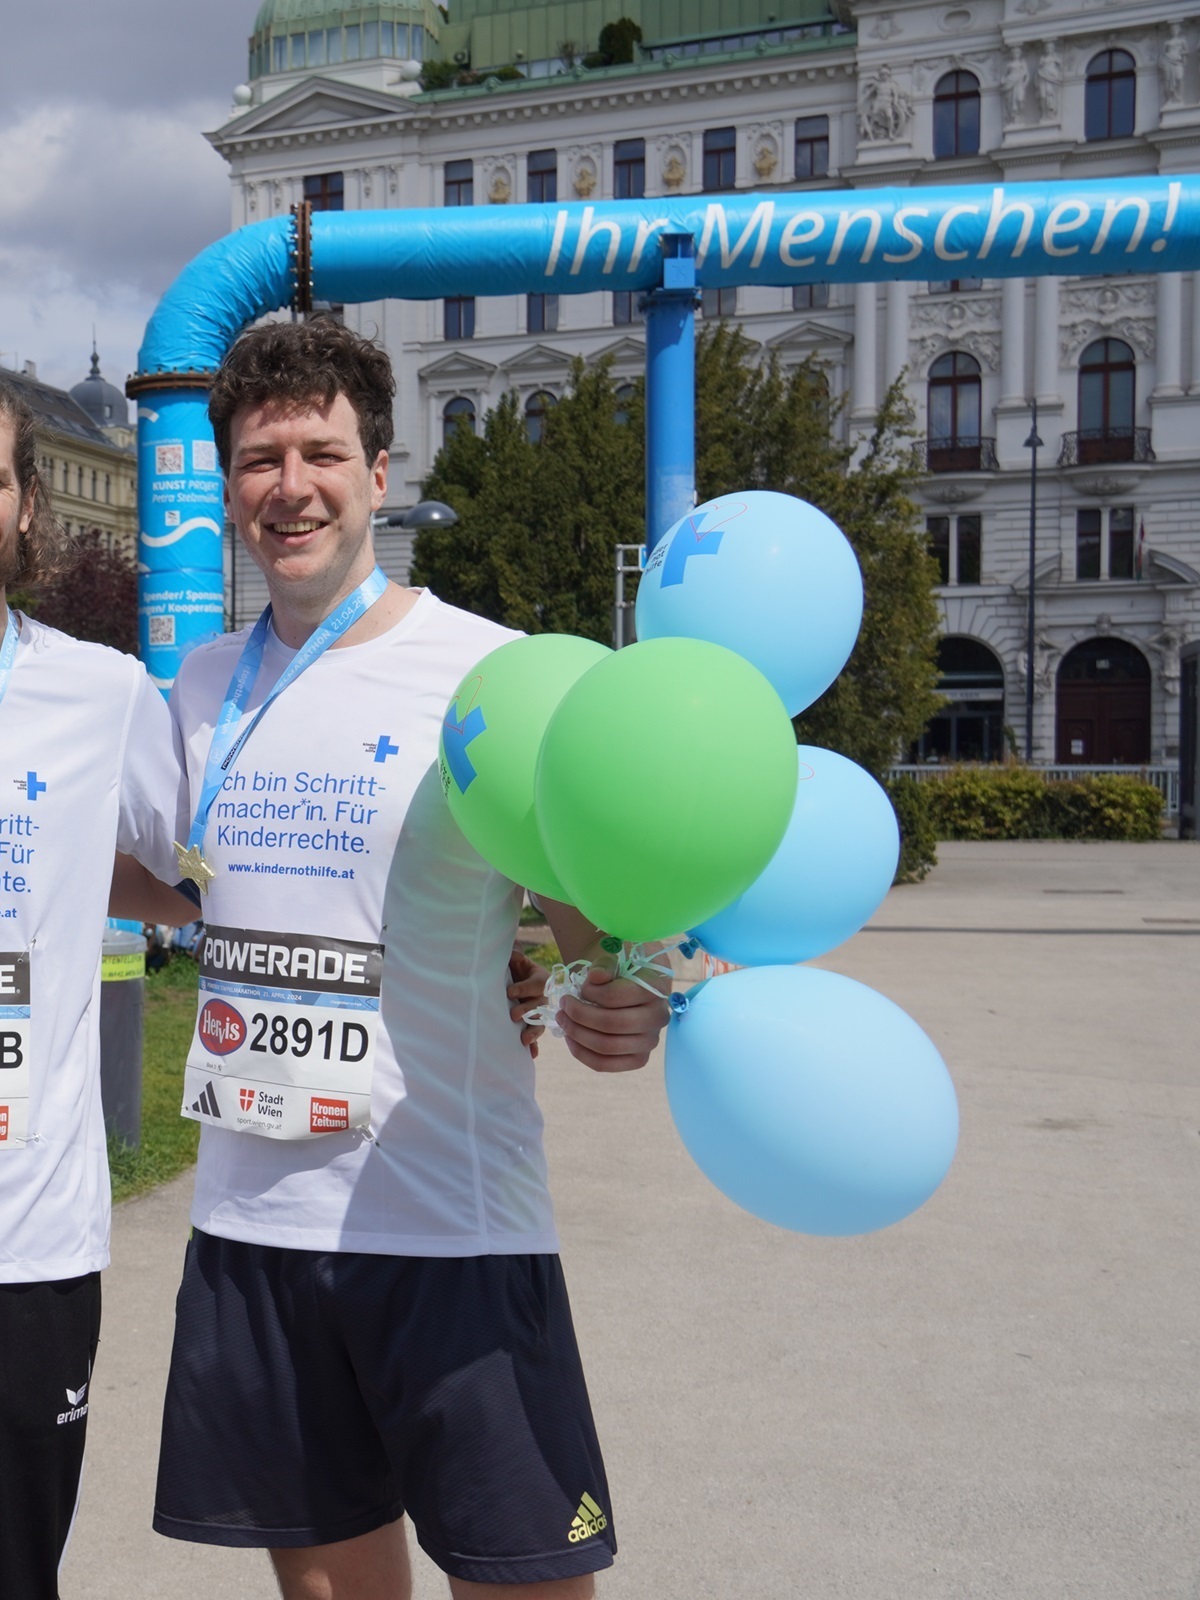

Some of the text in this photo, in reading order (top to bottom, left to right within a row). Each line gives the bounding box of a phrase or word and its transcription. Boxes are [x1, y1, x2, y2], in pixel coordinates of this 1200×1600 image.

[543, 181, 1182, 276] Ihr Menschen!
[152, 480, 186, 491] KUNST
[222, 771, 386, 796] ch bin Schritt-
[335, 801, 378, 824] Für
[217, 825, 370, 854] Kinderrechte.
[228, 863, 355, 880] www.kindernothilfe.at
[202, 1009, 369, 1063] Hervis 2891D
[258, 1091, 347, 1116] Stadt Kronen
[258, 1103, 347, 1129] Wien Zeitung
[237, 1117, 282, 1131] sport.wien.gv.at
